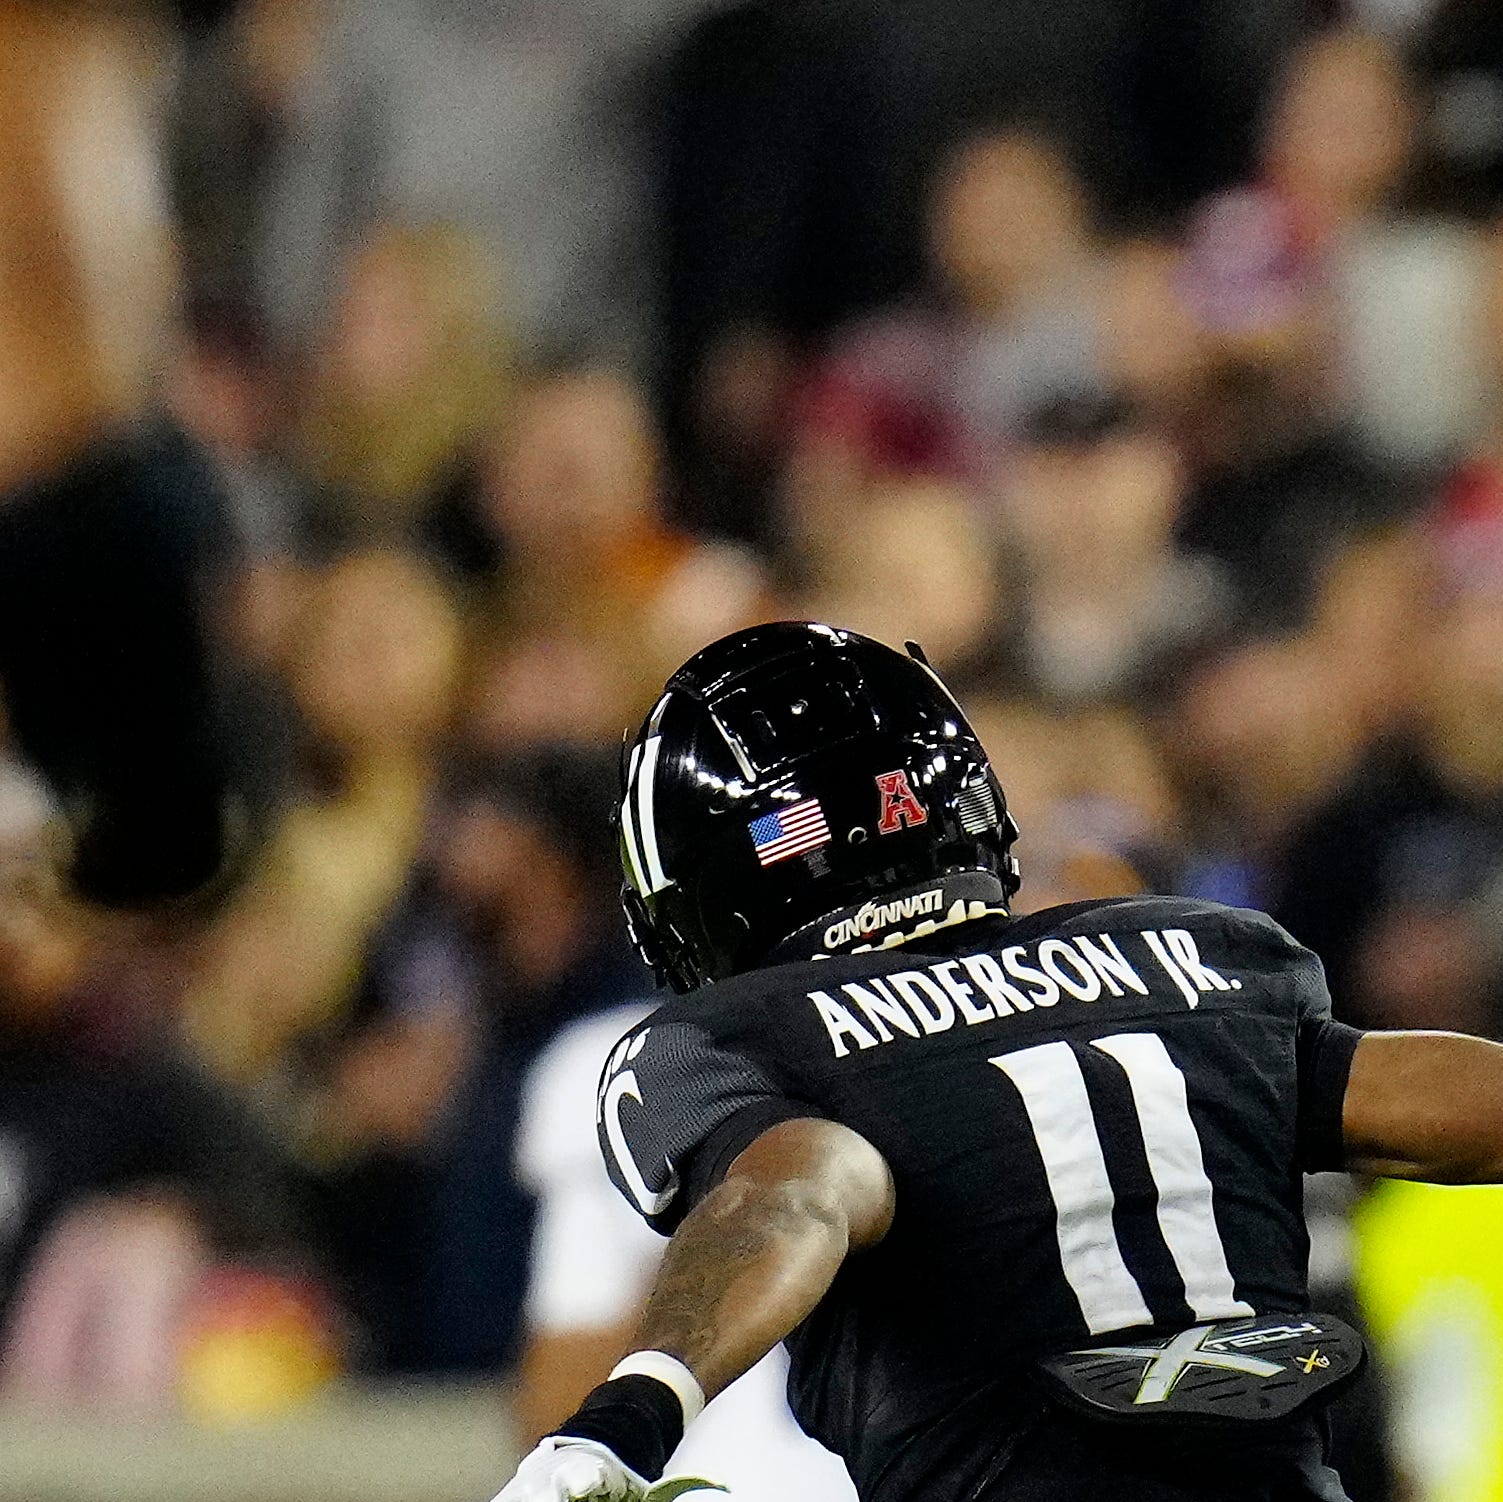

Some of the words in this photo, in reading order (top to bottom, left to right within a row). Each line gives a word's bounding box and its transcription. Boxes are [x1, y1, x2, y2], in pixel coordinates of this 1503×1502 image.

[823, 888, 945, 950] CINCINNATI
[806, 932, 1149, 1058] ANDERSON
[1140, 928, 1243, 1009] JR.
[988, 1032, 1256, 1335] 11
